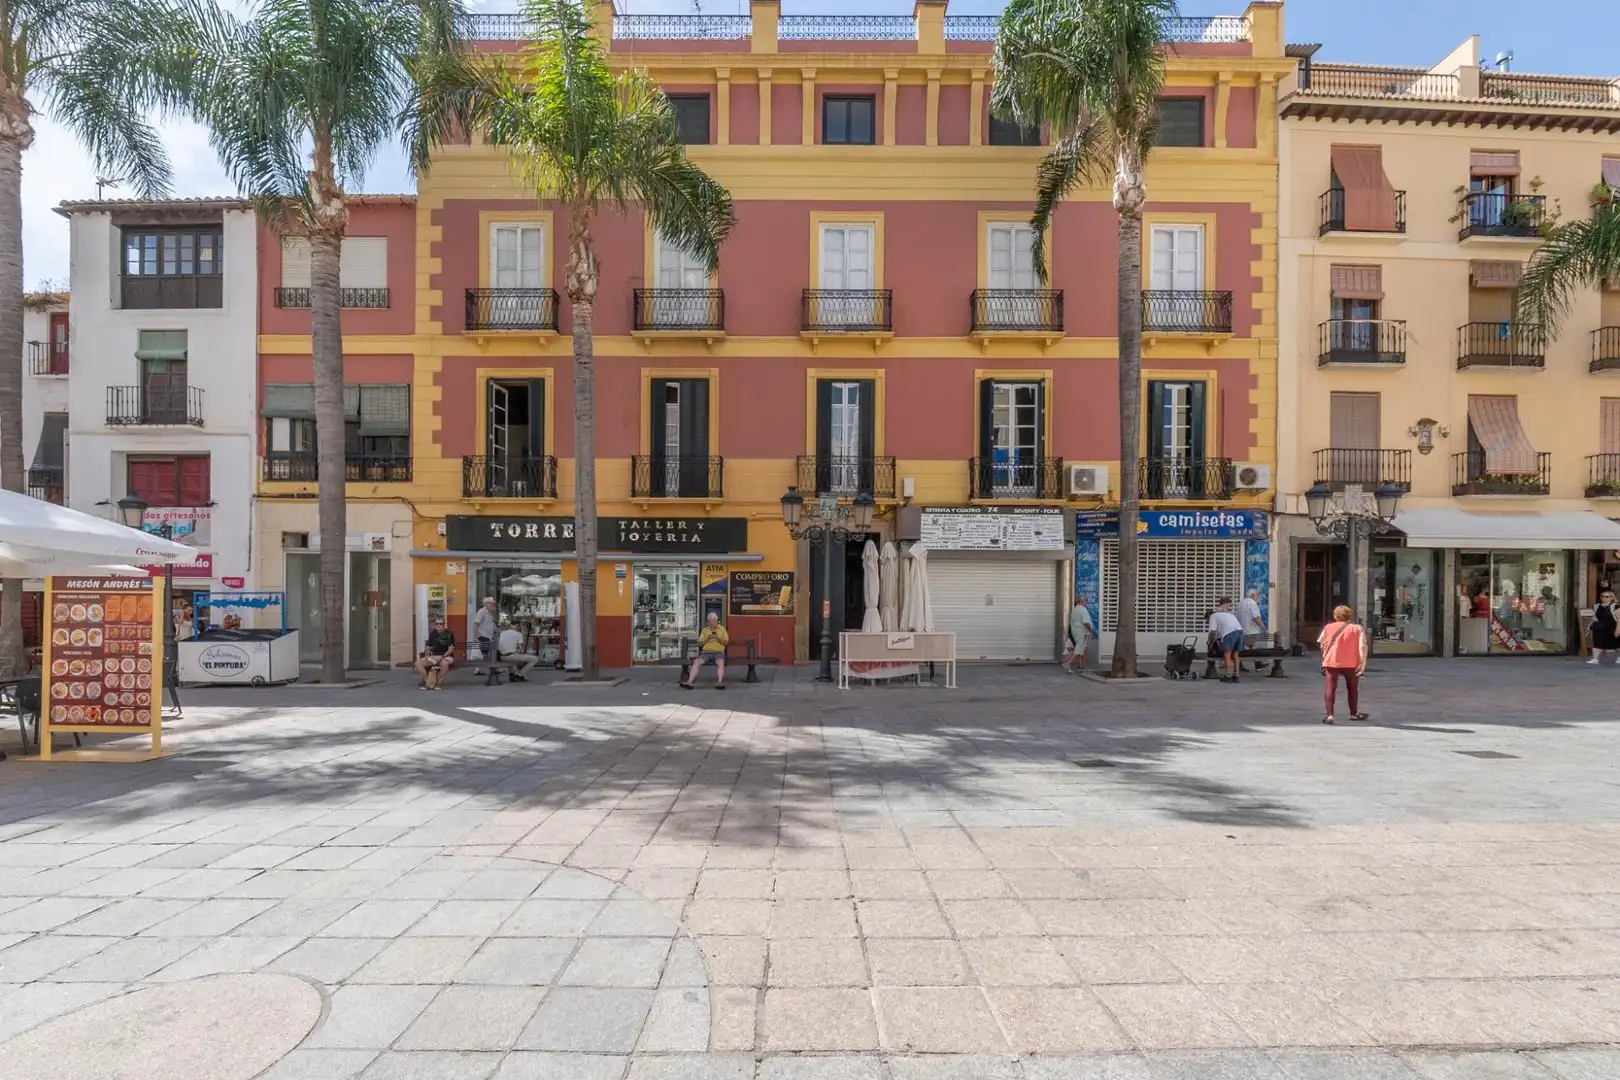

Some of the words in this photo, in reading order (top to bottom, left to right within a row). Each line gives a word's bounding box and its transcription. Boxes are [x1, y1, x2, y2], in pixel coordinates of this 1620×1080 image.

[619, 520, 688, 530] TALLER
[698, 522, 705, 530] Y
[1159, 512, 1245, 528] camisetas
[620, 532, 702, 543] JOYERIA
[735, 573, 770, 581] COMPRO
[771, 573, 789, 581] ORO
[66, 579, 100, 588] MESÓN
[103, 579, 141, 588] ANDRÉS
